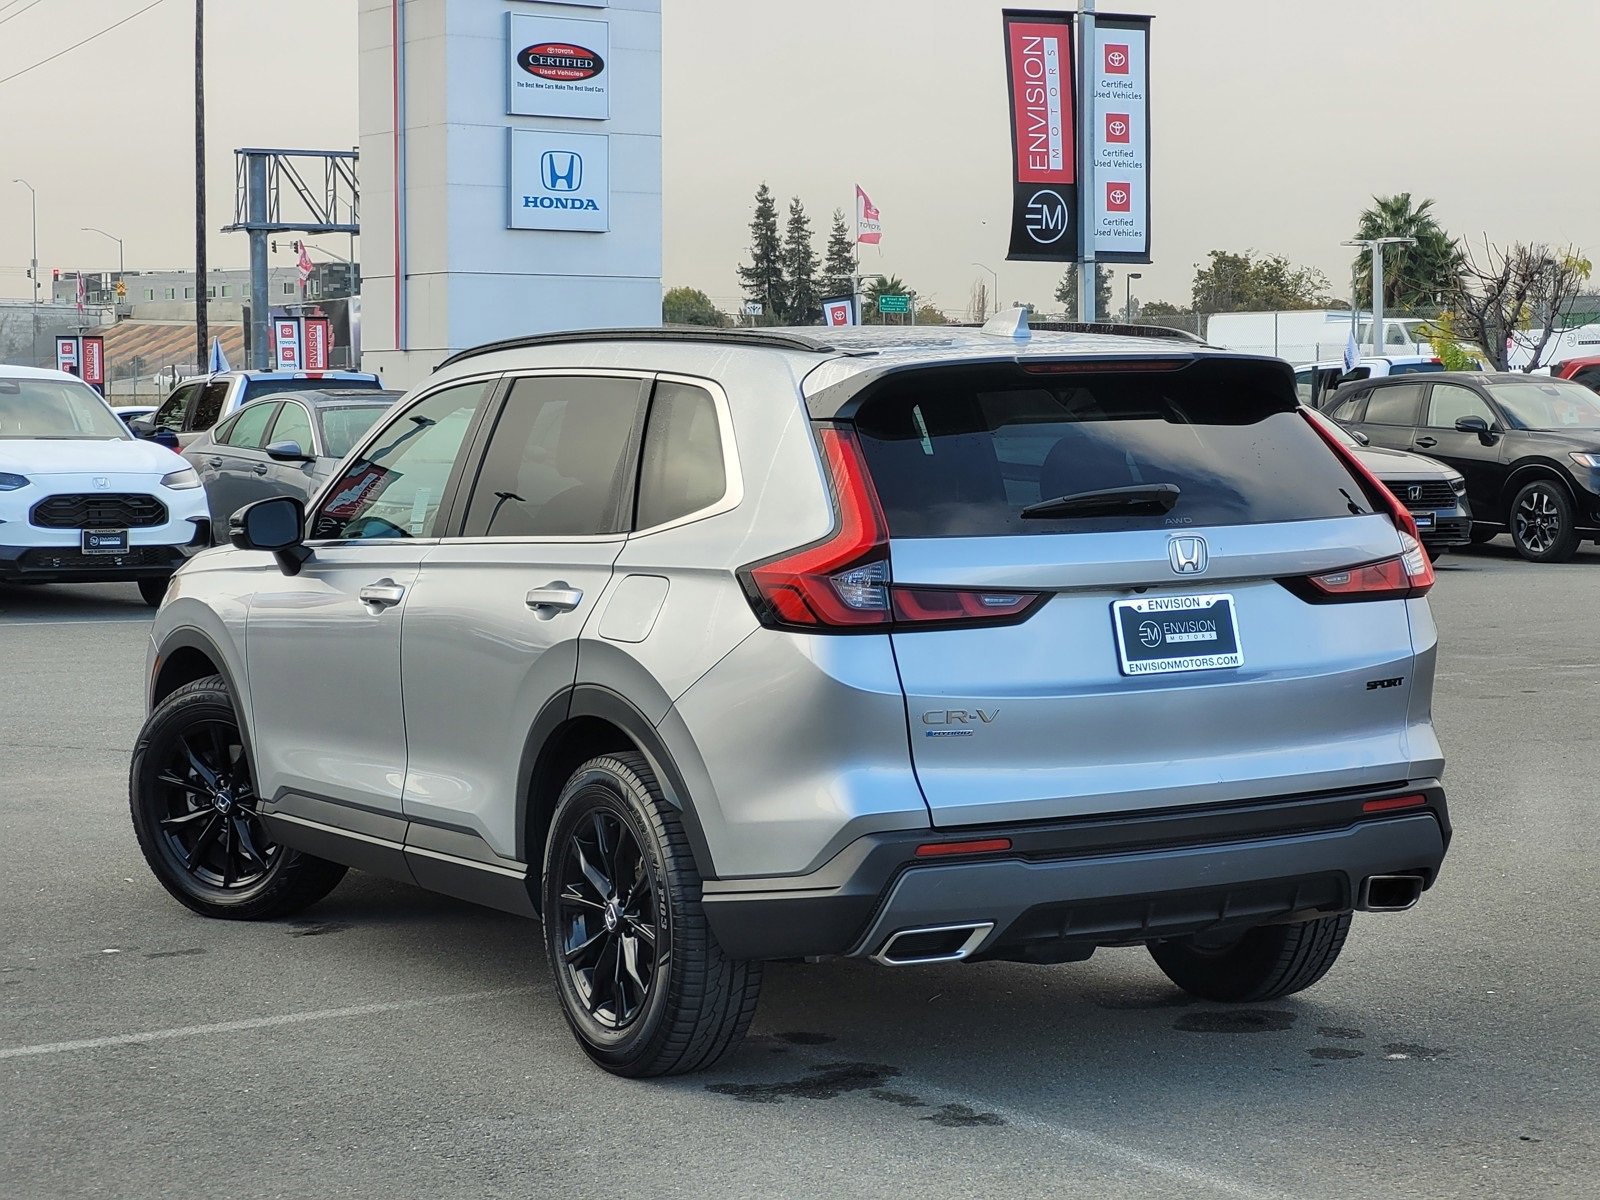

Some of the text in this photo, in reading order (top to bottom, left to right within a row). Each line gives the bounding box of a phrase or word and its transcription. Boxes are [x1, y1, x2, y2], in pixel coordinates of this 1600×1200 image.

[529, 54, 594, 68] CERTIFIED
[1101, 80, 1133, 89] Certified
[1112, 91, 1142, 100] Vehicles
[1022, 36, 1048, 170] ENVISION
[1048, 49, 1060, 159] MOTORS
[1102, 149, 1134, 158] Certified
[1094, 159, 1143, 169] Used Vehicles
[523, 196, 599, 211] HONDA
[1102, 218, 1134, 226] Certified
[1113, 229, 1142, 237] Vehicles
[309, 324, 317, 368] ENVISION
[1165, 517, 1193, 525] AWD
[1147, 597, 1200, 611] ENVISION
[1163, 620, 1216, 634] ENVISION
[1129, 656, 1239, 673] ENVISIONMOTORS.COM
[1366, 676, 1405, 690] SPORT
[922, 708, 1000, 725] CR-V
[657, 888, 668, 930] P03
